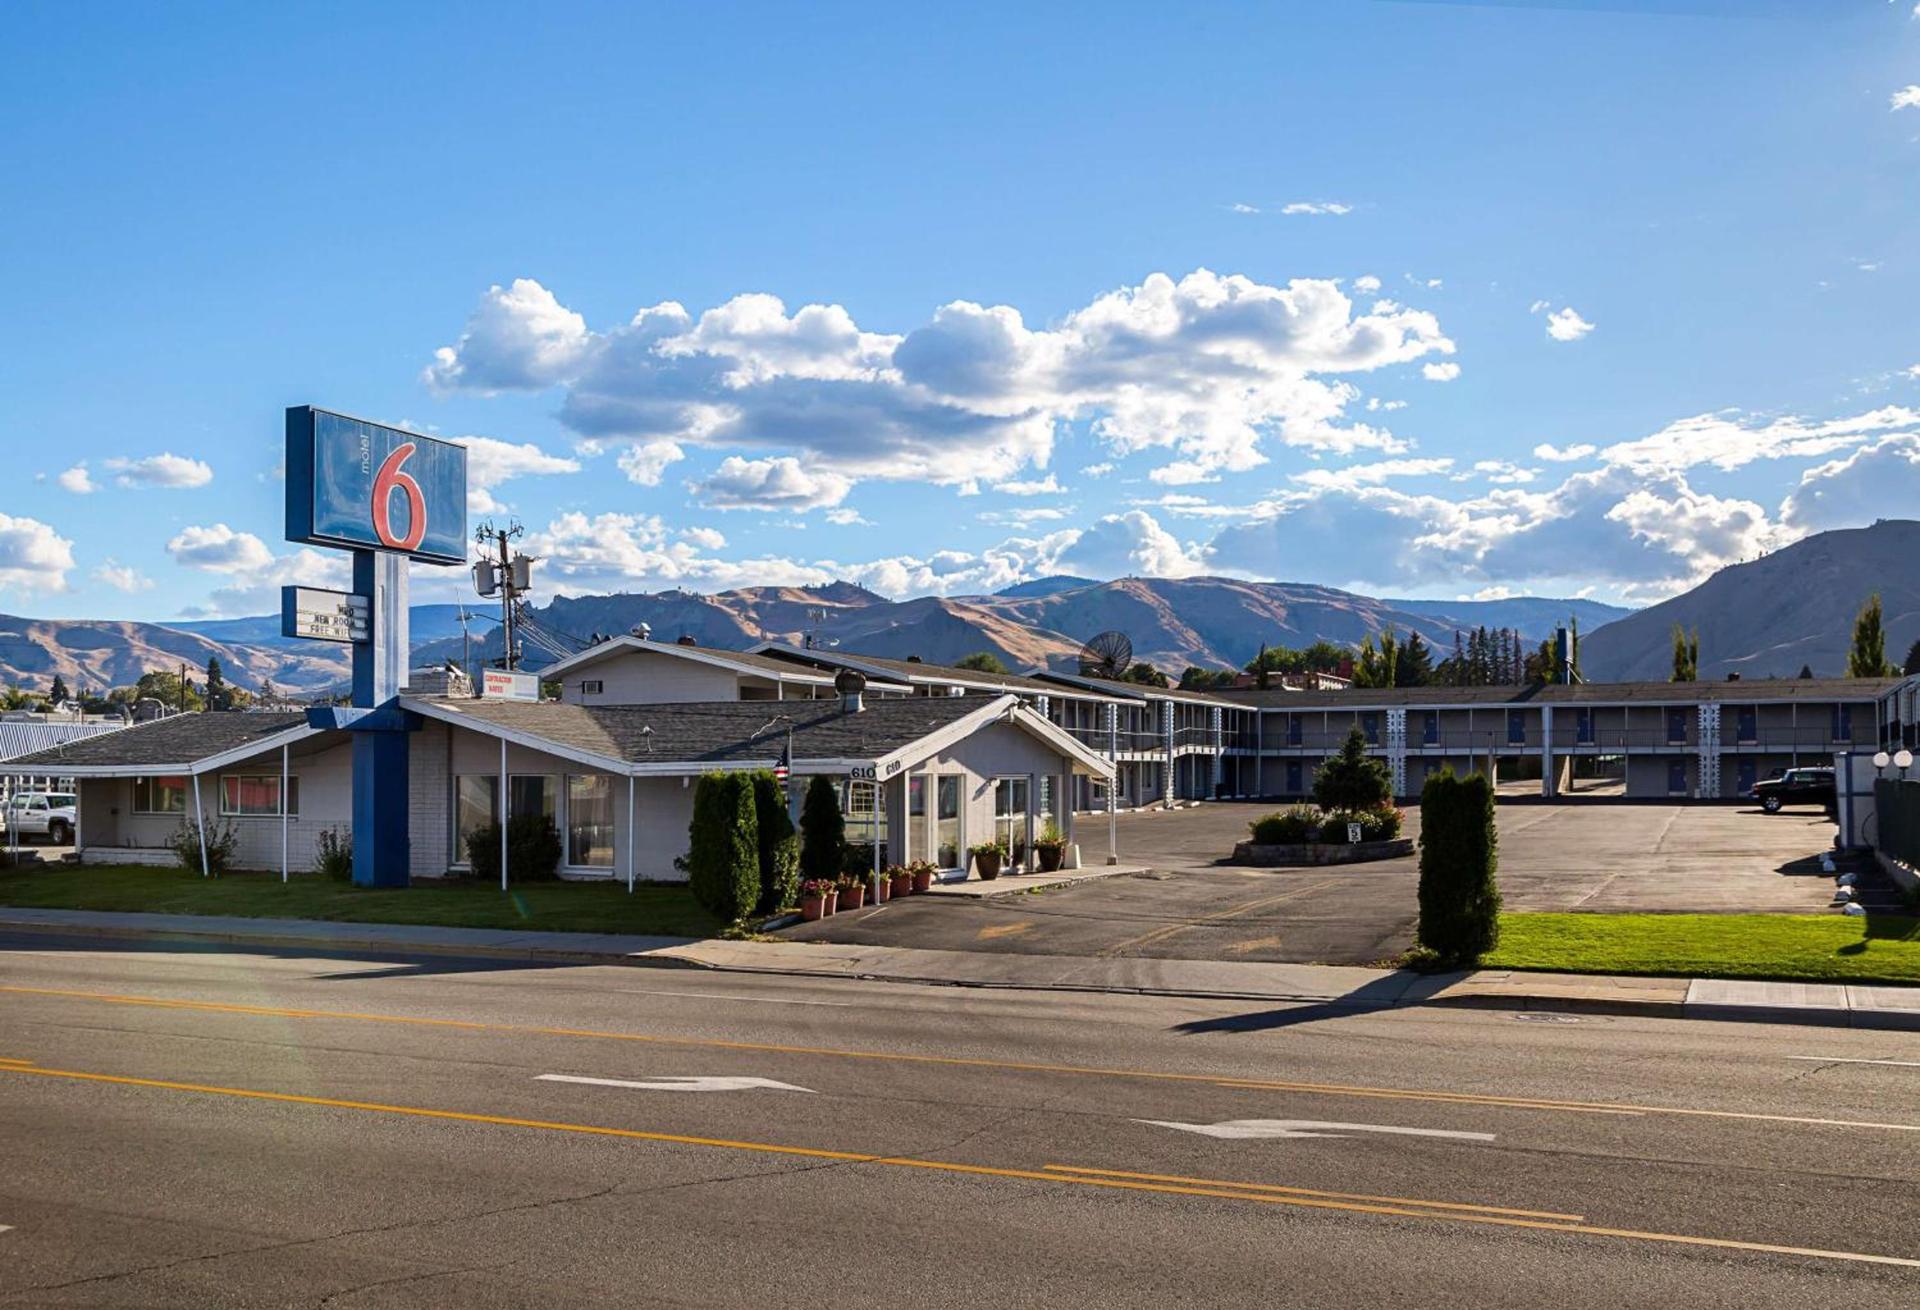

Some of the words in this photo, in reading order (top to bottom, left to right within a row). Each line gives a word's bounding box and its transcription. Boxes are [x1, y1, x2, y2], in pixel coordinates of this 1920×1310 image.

[360, 434, 370, 475] motel
[370, 441, 427, 551] 6
[310, 624, 328, 634] FREE
[851, 767, 876, 778] 610
[886, 760, 901, 775] 610
